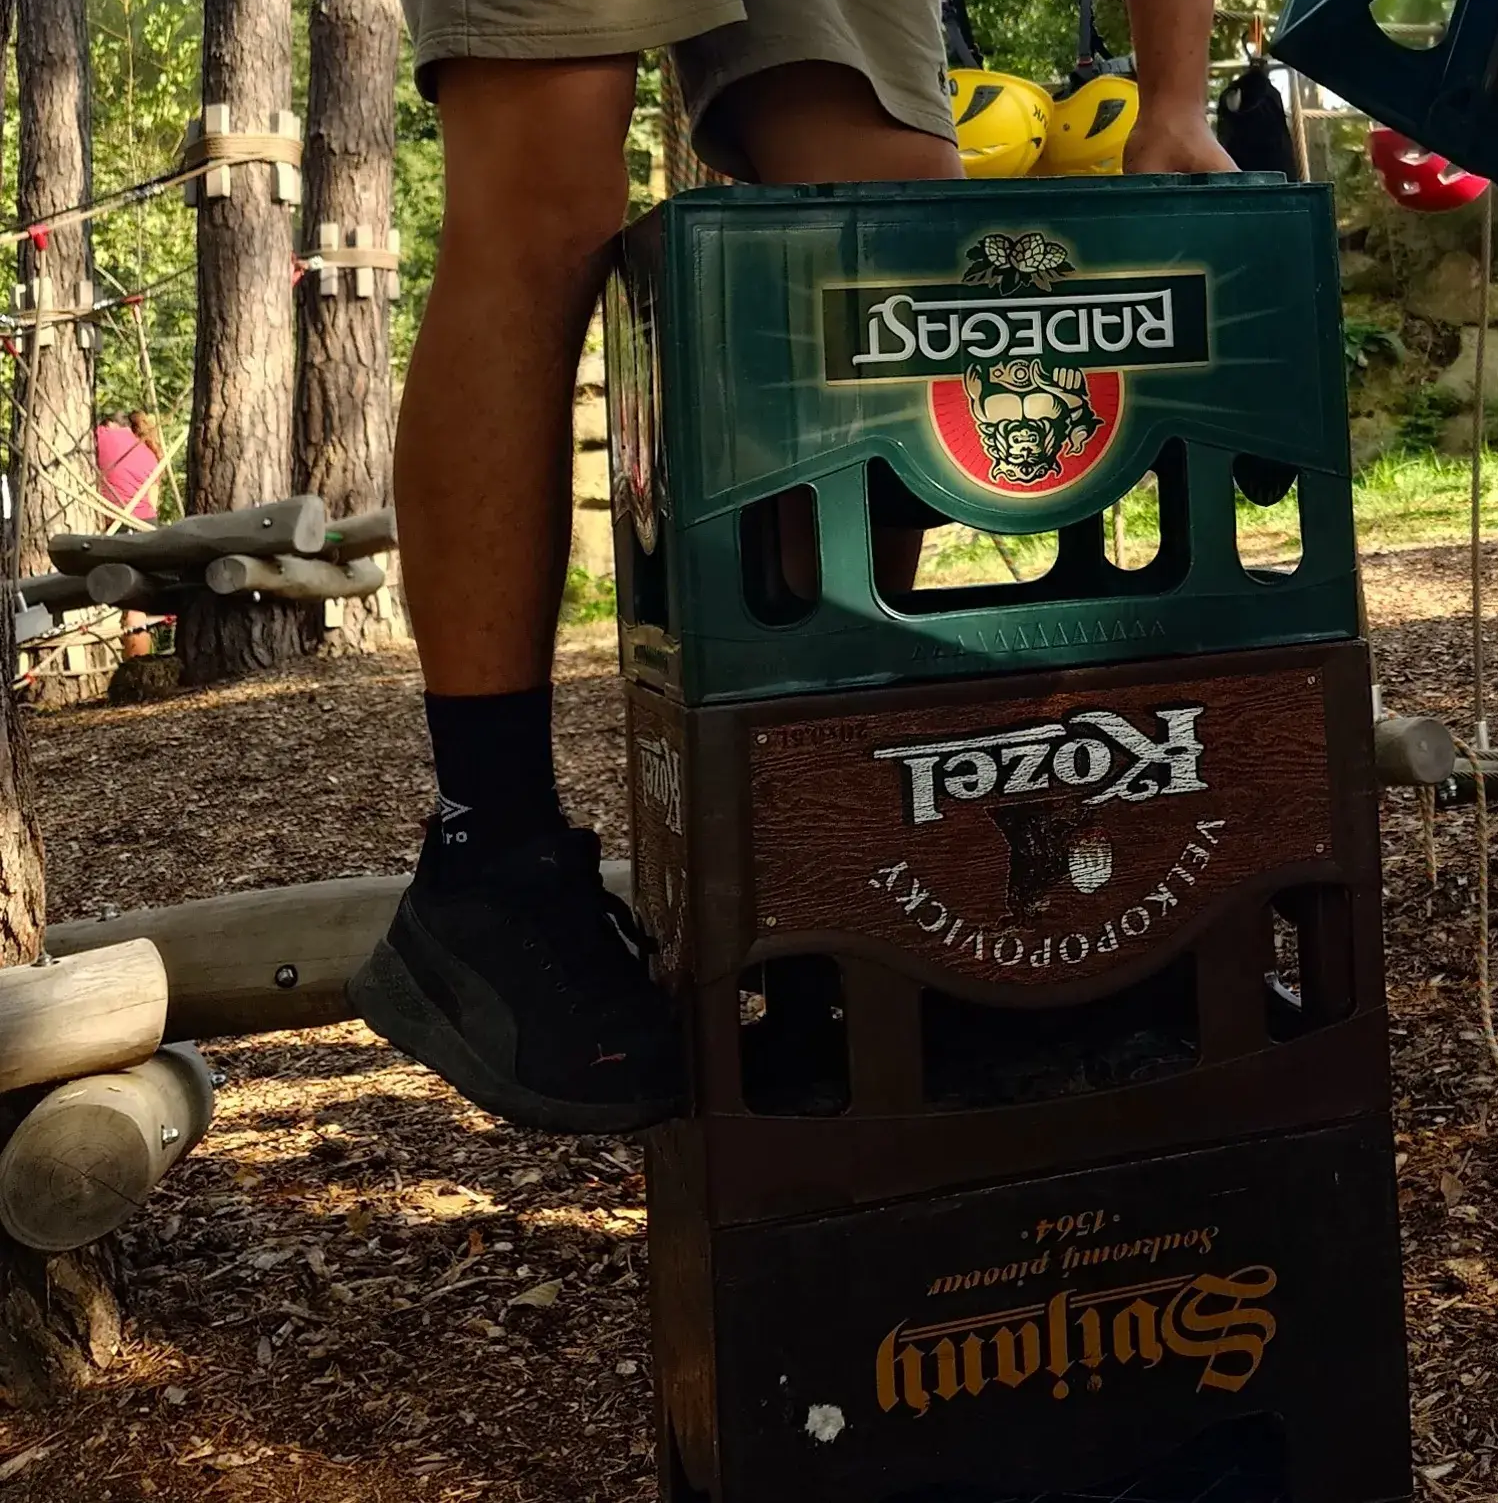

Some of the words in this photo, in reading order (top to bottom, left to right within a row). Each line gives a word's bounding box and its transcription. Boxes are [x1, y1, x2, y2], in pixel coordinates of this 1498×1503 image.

[852, 288, 1174, 365] RADEGAST
[874, 706, 1209, 825] Kozel
[926, 1250, 1053, 1298] pivovar
[1060, 1225, 1222, 1279] Soukromý
[876, 1264, 1278, 1419] Svijany
